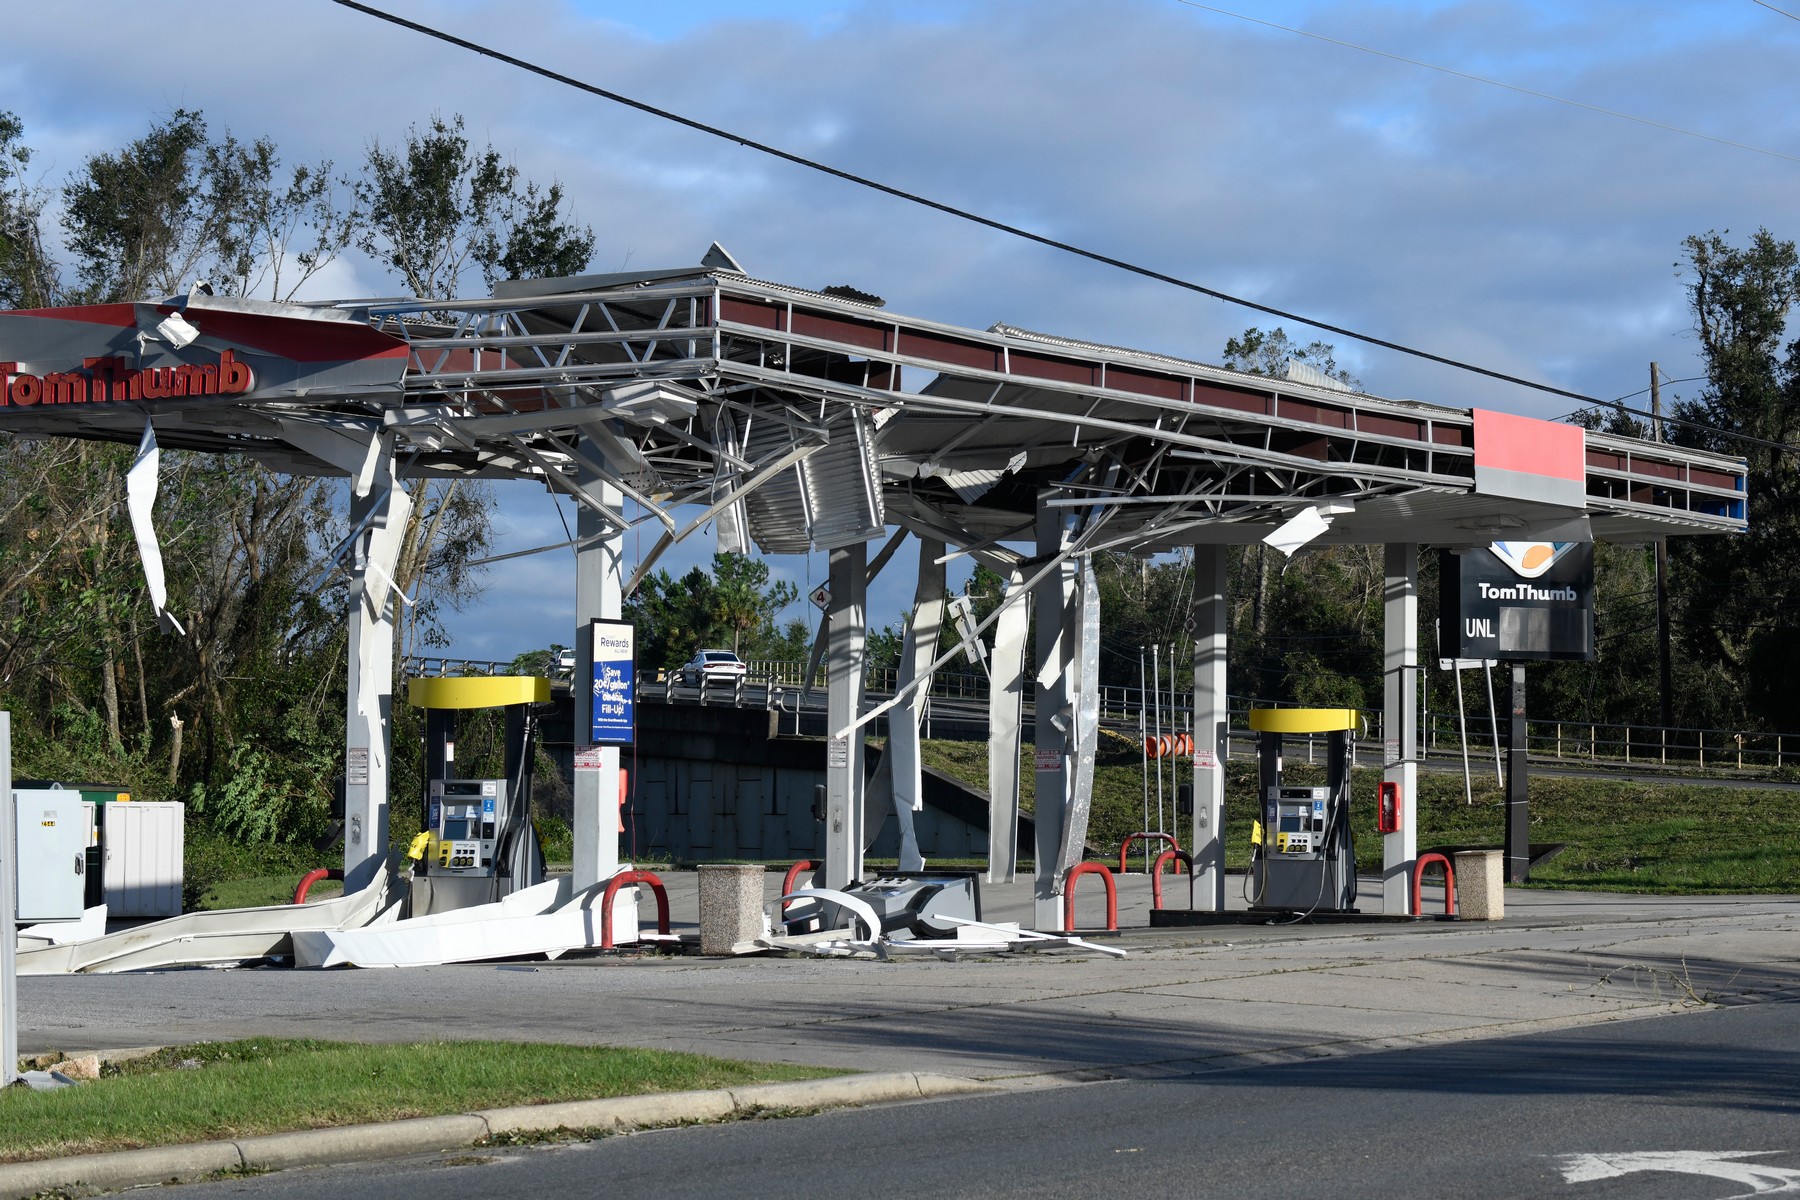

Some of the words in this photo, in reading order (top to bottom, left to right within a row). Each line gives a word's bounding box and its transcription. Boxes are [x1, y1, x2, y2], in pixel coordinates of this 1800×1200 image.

[0, 348, 252, 407] TomThumb
[816, 591, 825, 602] 4
[1478, 583, 1577, 601] TomThumb
[1465, 618, 1496, 638] UNL
[600, 637, 629, 648] Rewards
[606, 667, 621, 677] Save
[601, 704, 625, 716] Fill-Up!
